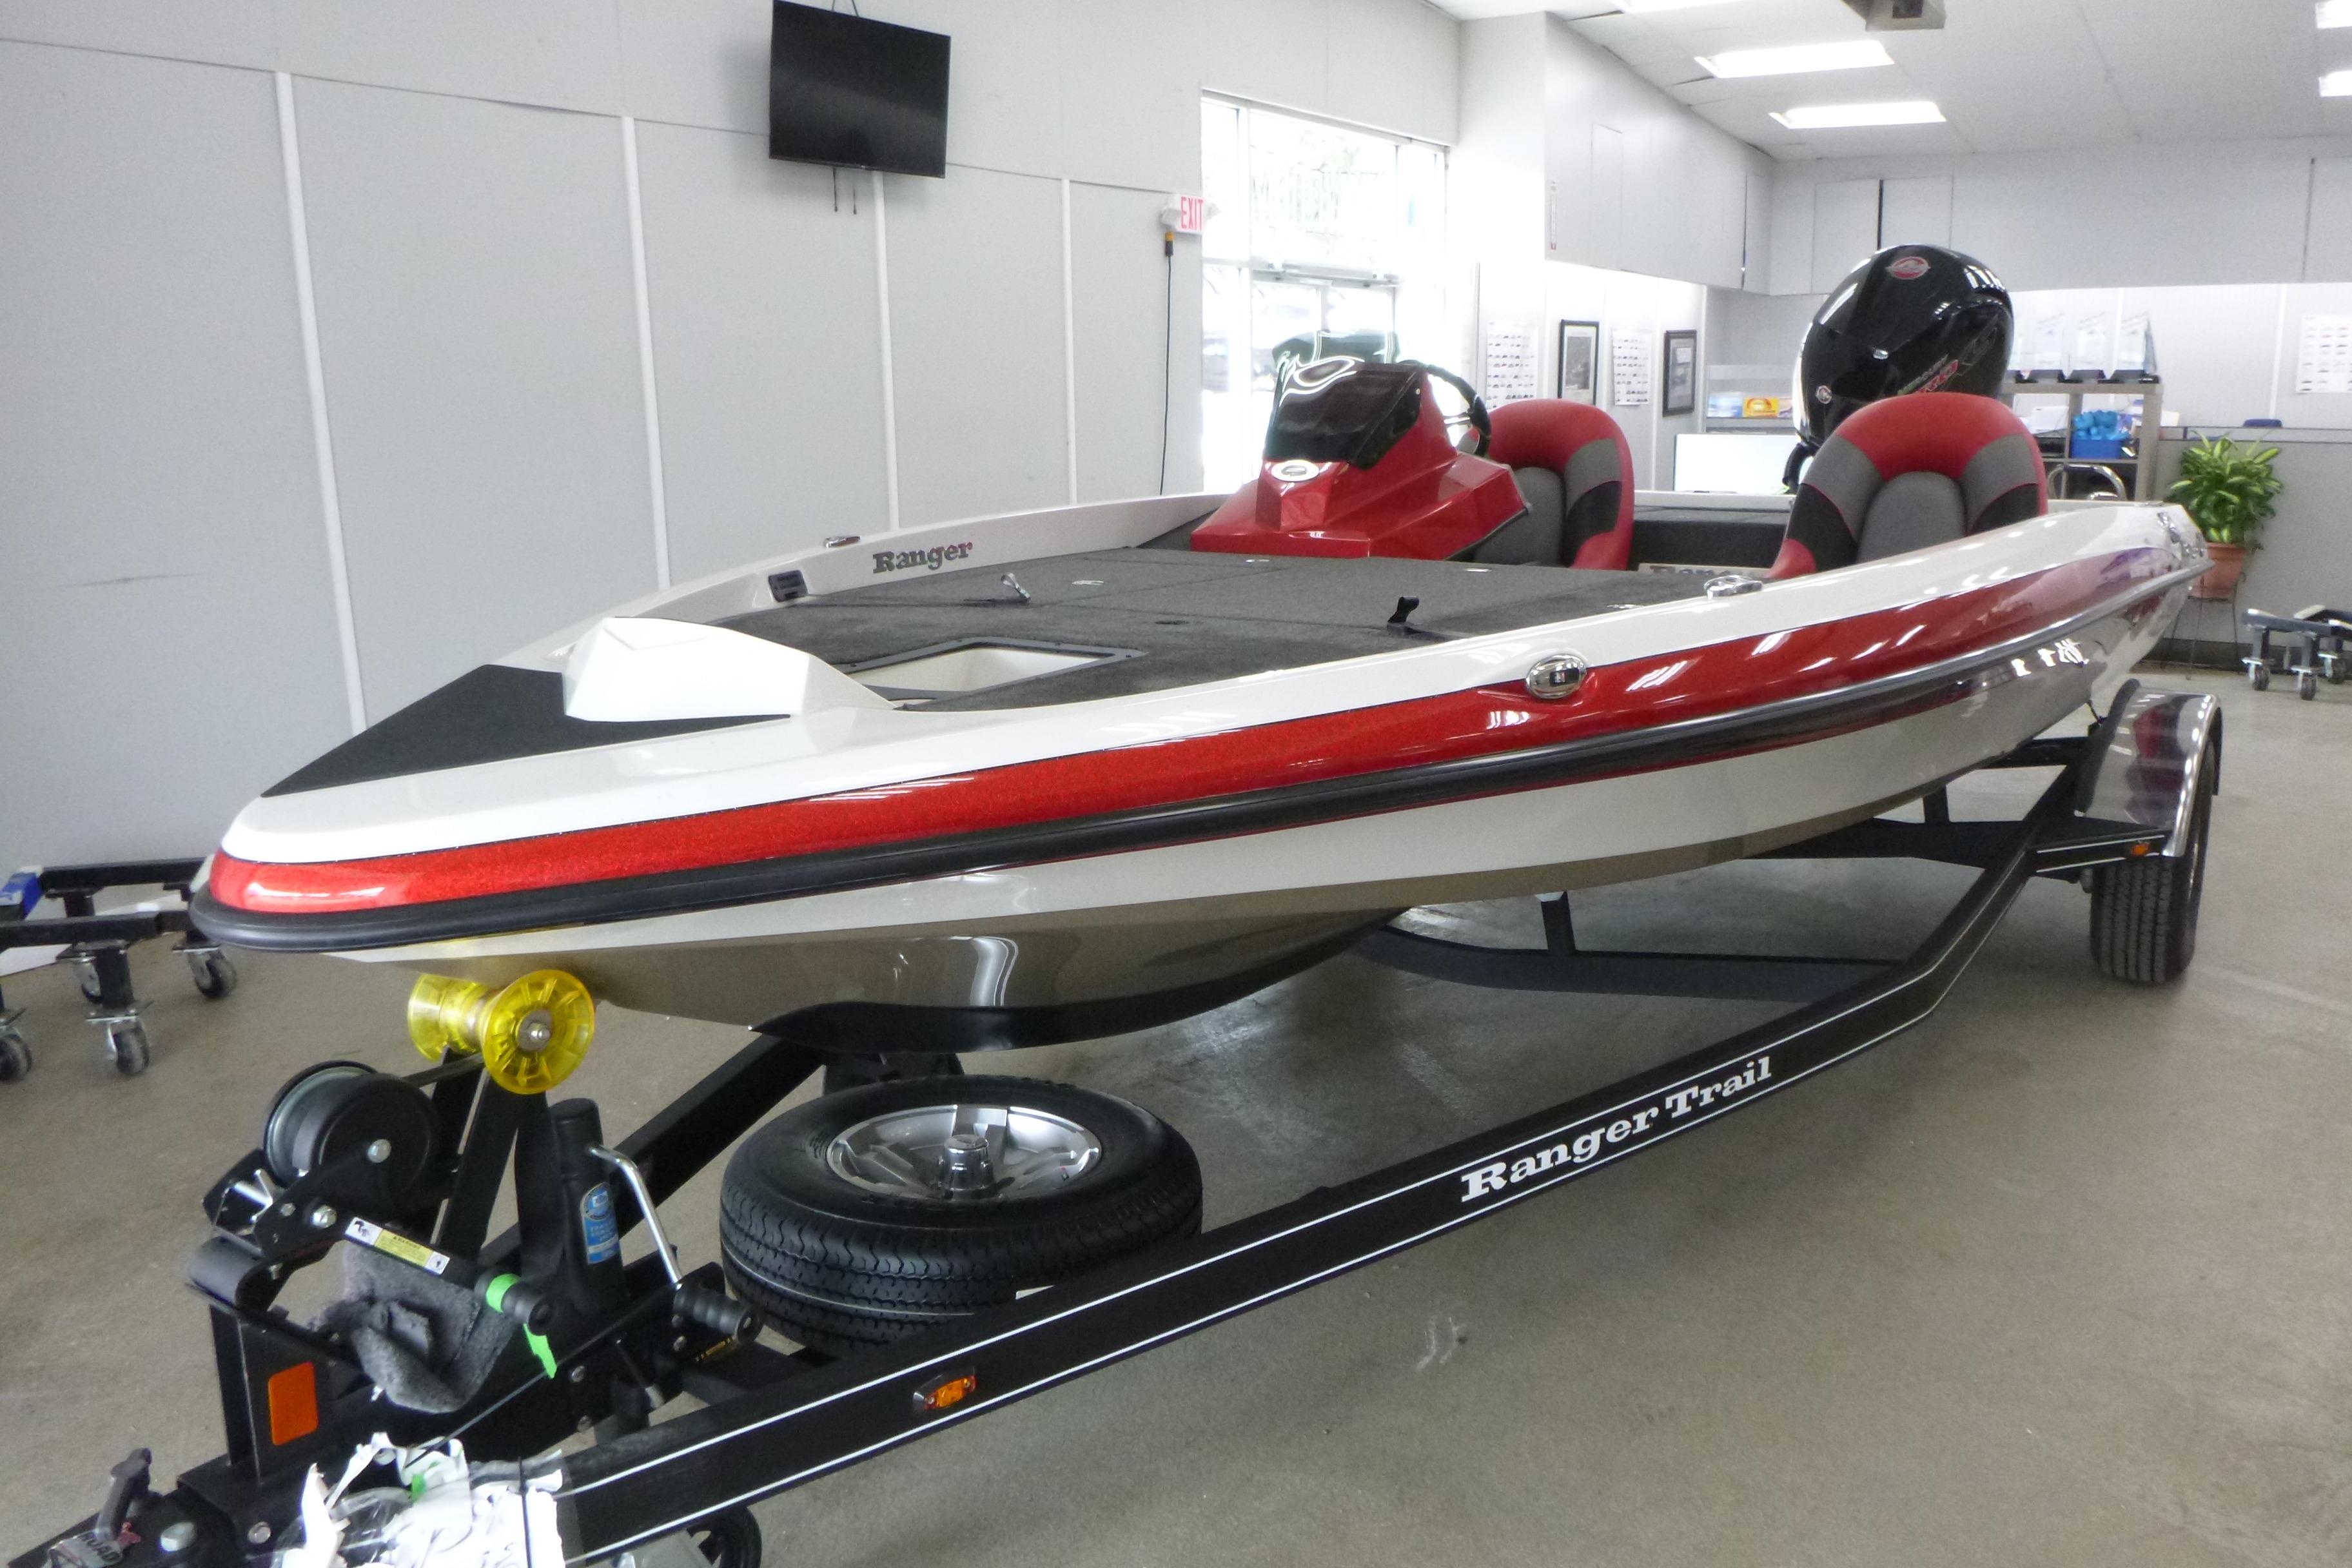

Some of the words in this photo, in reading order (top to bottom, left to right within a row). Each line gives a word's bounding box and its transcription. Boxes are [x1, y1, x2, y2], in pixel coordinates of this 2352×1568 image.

[1181, 197, 1204, 231] EXIT
[873, 542, 973, 574] Ranger
[1461, 1107, 1659, 1202] Ranger
[1665, 1055, 1772, 1119] Trail
